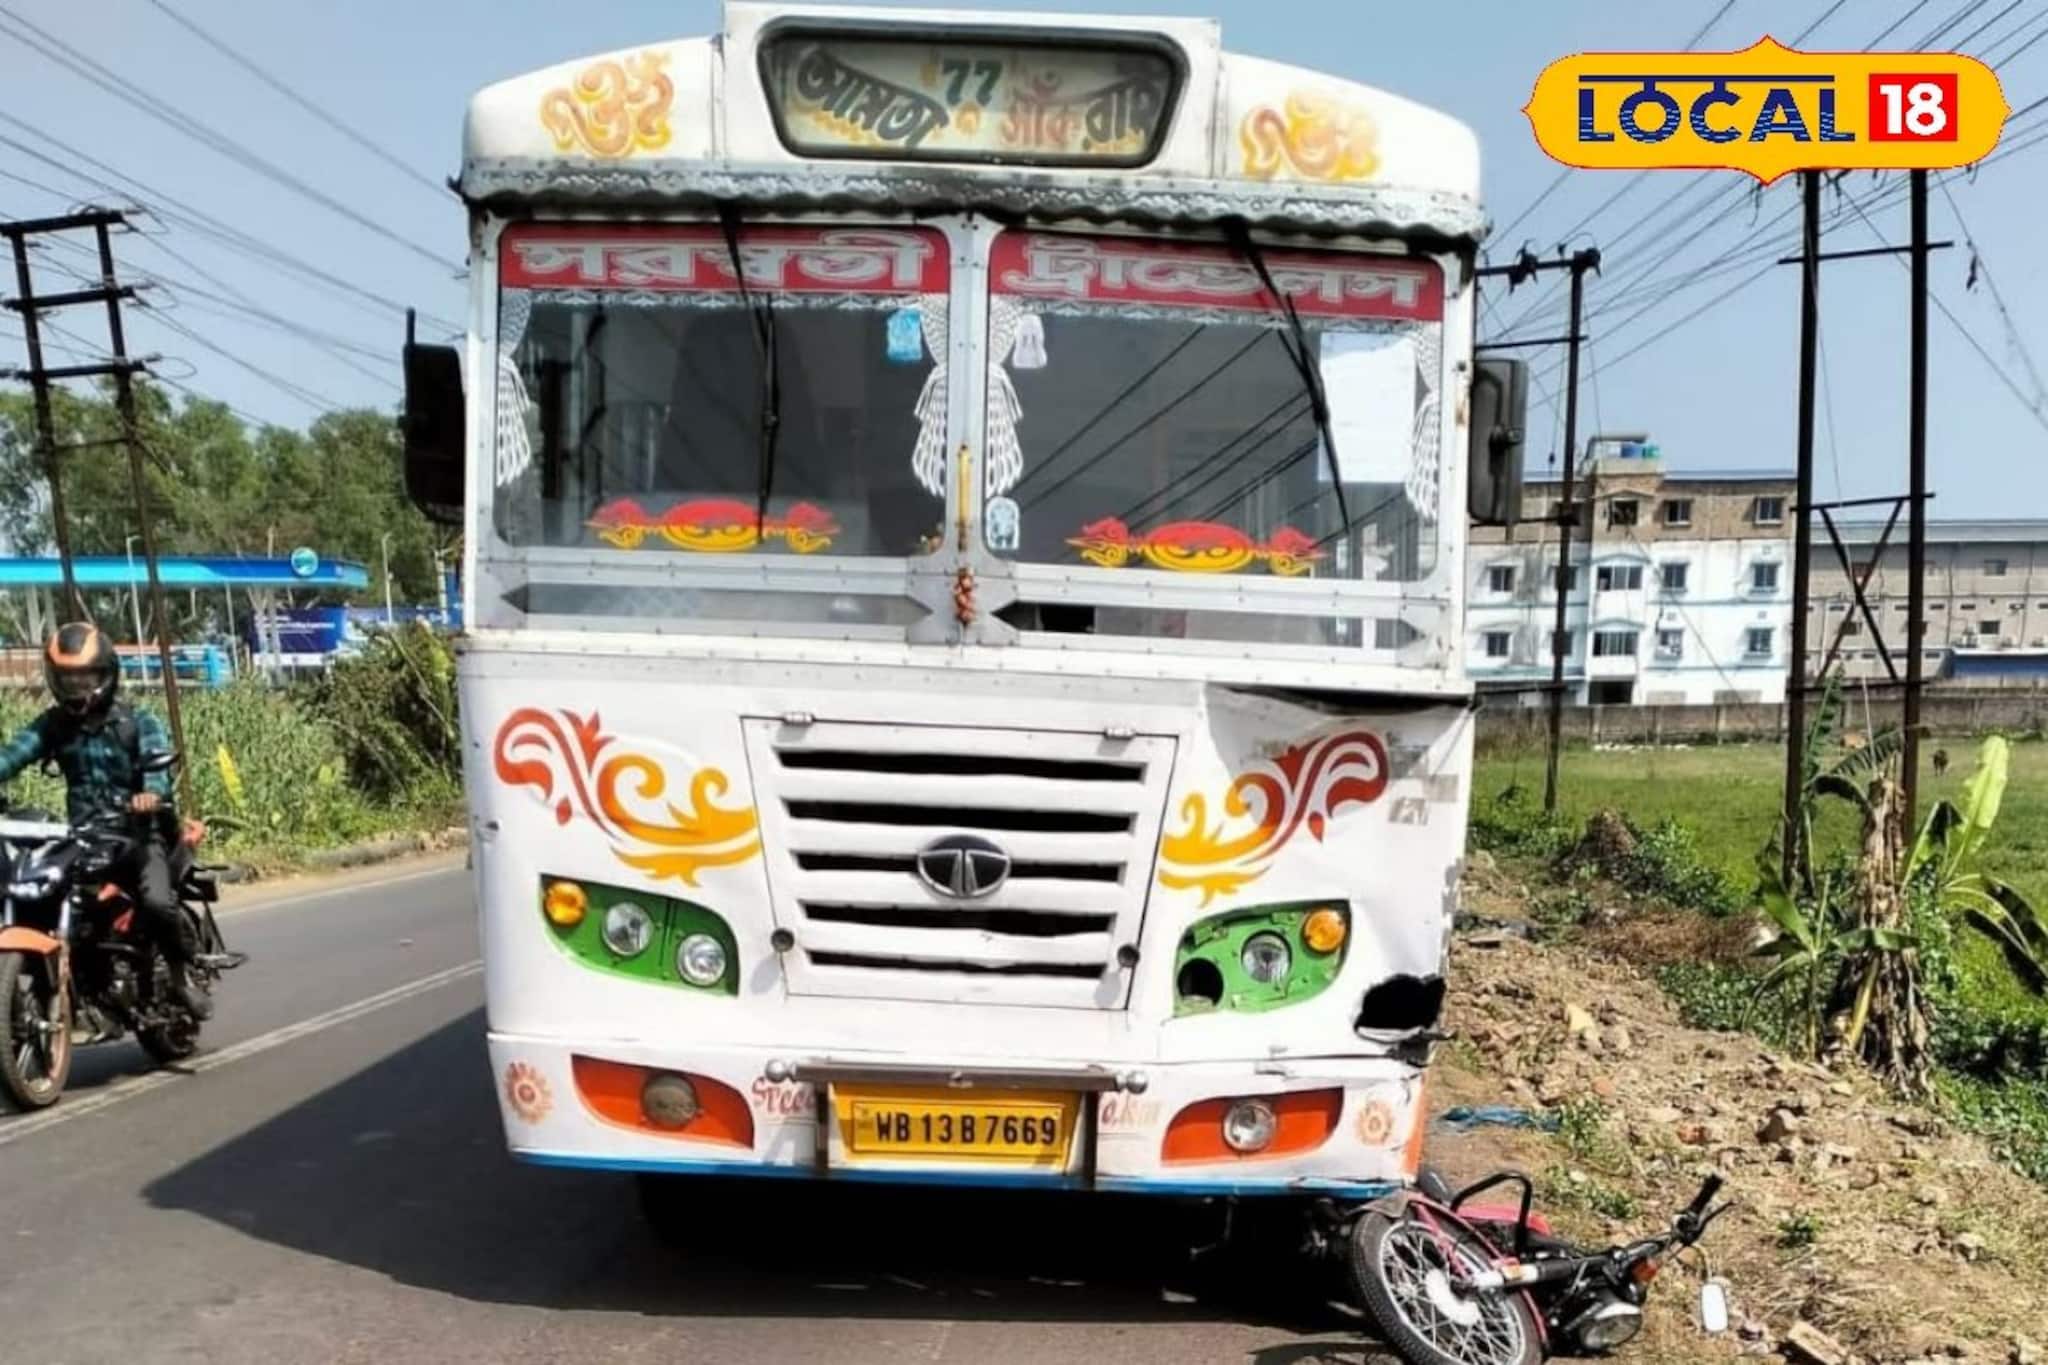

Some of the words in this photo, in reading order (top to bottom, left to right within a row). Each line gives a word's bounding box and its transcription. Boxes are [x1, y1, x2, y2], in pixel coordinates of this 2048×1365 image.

[940, 57, 1003, 107] 77
[512, 230, 934, 288] সরস্বতী
[1001, 235, 1427, 306] ট্রাভেলস
[876, 1111, 910, 1142] WB
[985, 1115, 1057, 1145] 7669
